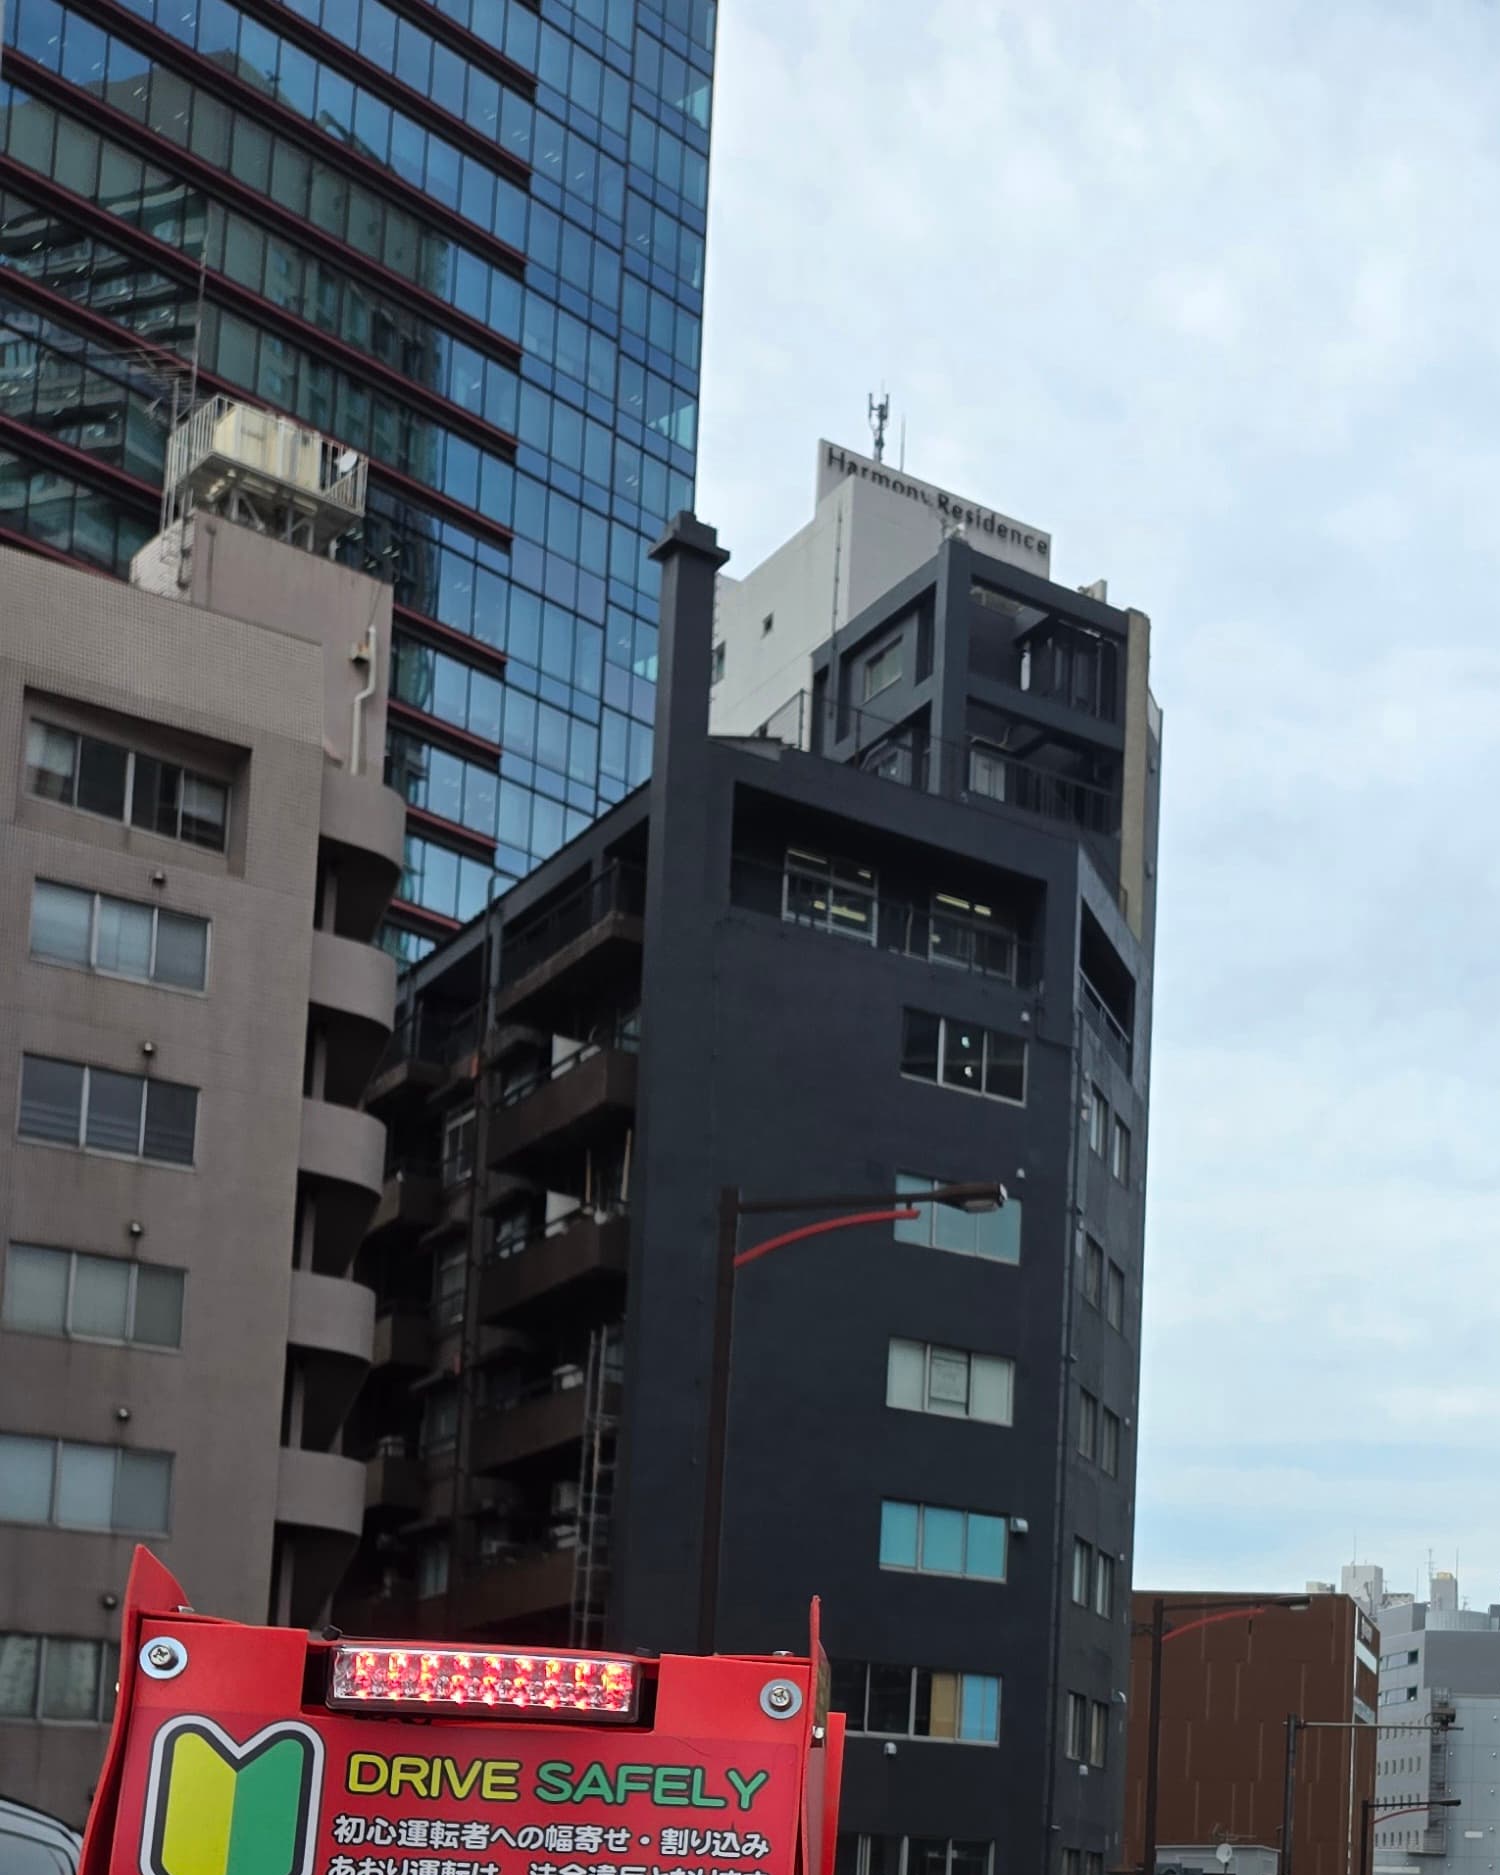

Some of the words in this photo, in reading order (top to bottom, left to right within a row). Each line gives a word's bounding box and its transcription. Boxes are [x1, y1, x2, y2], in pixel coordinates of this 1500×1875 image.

[938, 493, 1048, 555] Residence
[347, 1753, 519, 1801] DRIVE
[535, 1763, 768, 1810] SAFELY
[334, 1816, 769, 1858] 初心運転者への幅寄せ・割り込み
